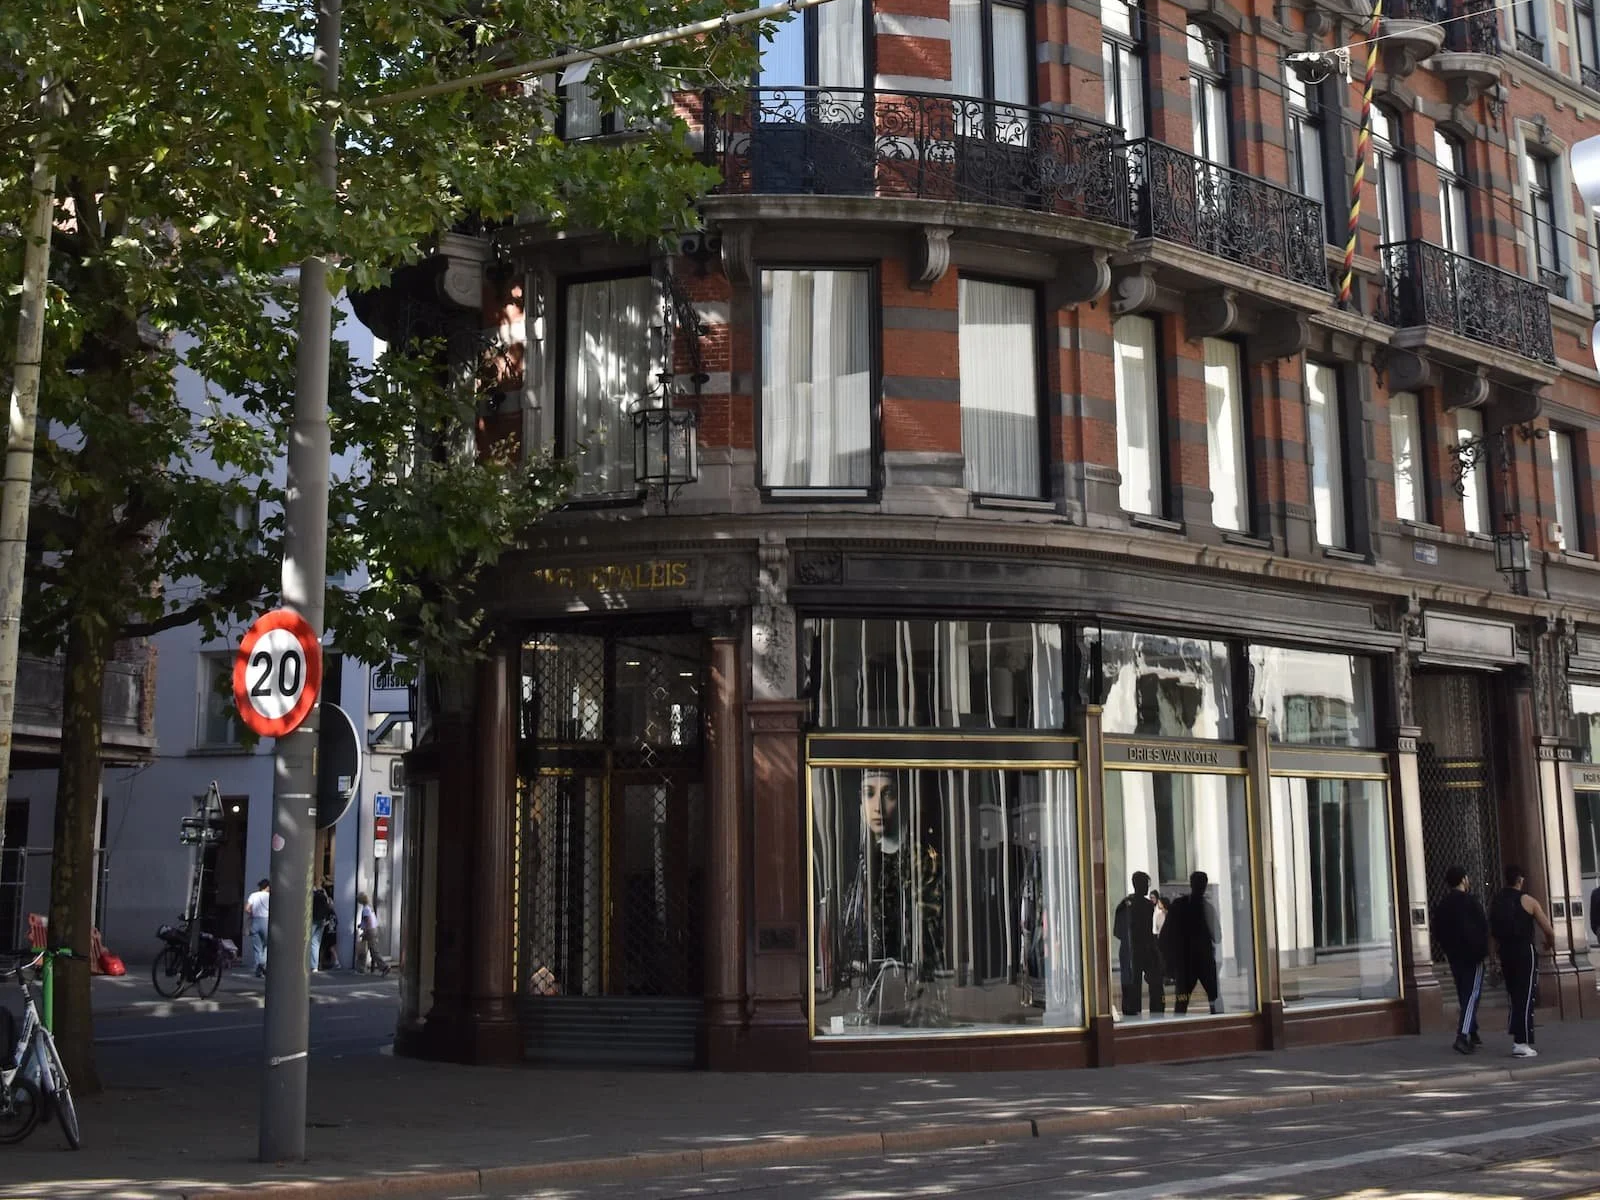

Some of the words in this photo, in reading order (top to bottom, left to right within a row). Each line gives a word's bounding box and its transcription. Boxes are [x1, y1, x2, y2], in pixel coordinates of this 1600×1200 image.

[251, 650, 300, 697] 20
[1127, 747, 1160, 761] DRIES
[1162, 748, 1182, 762] VAN
[1184, 749, 1219, 765] NOTEN
